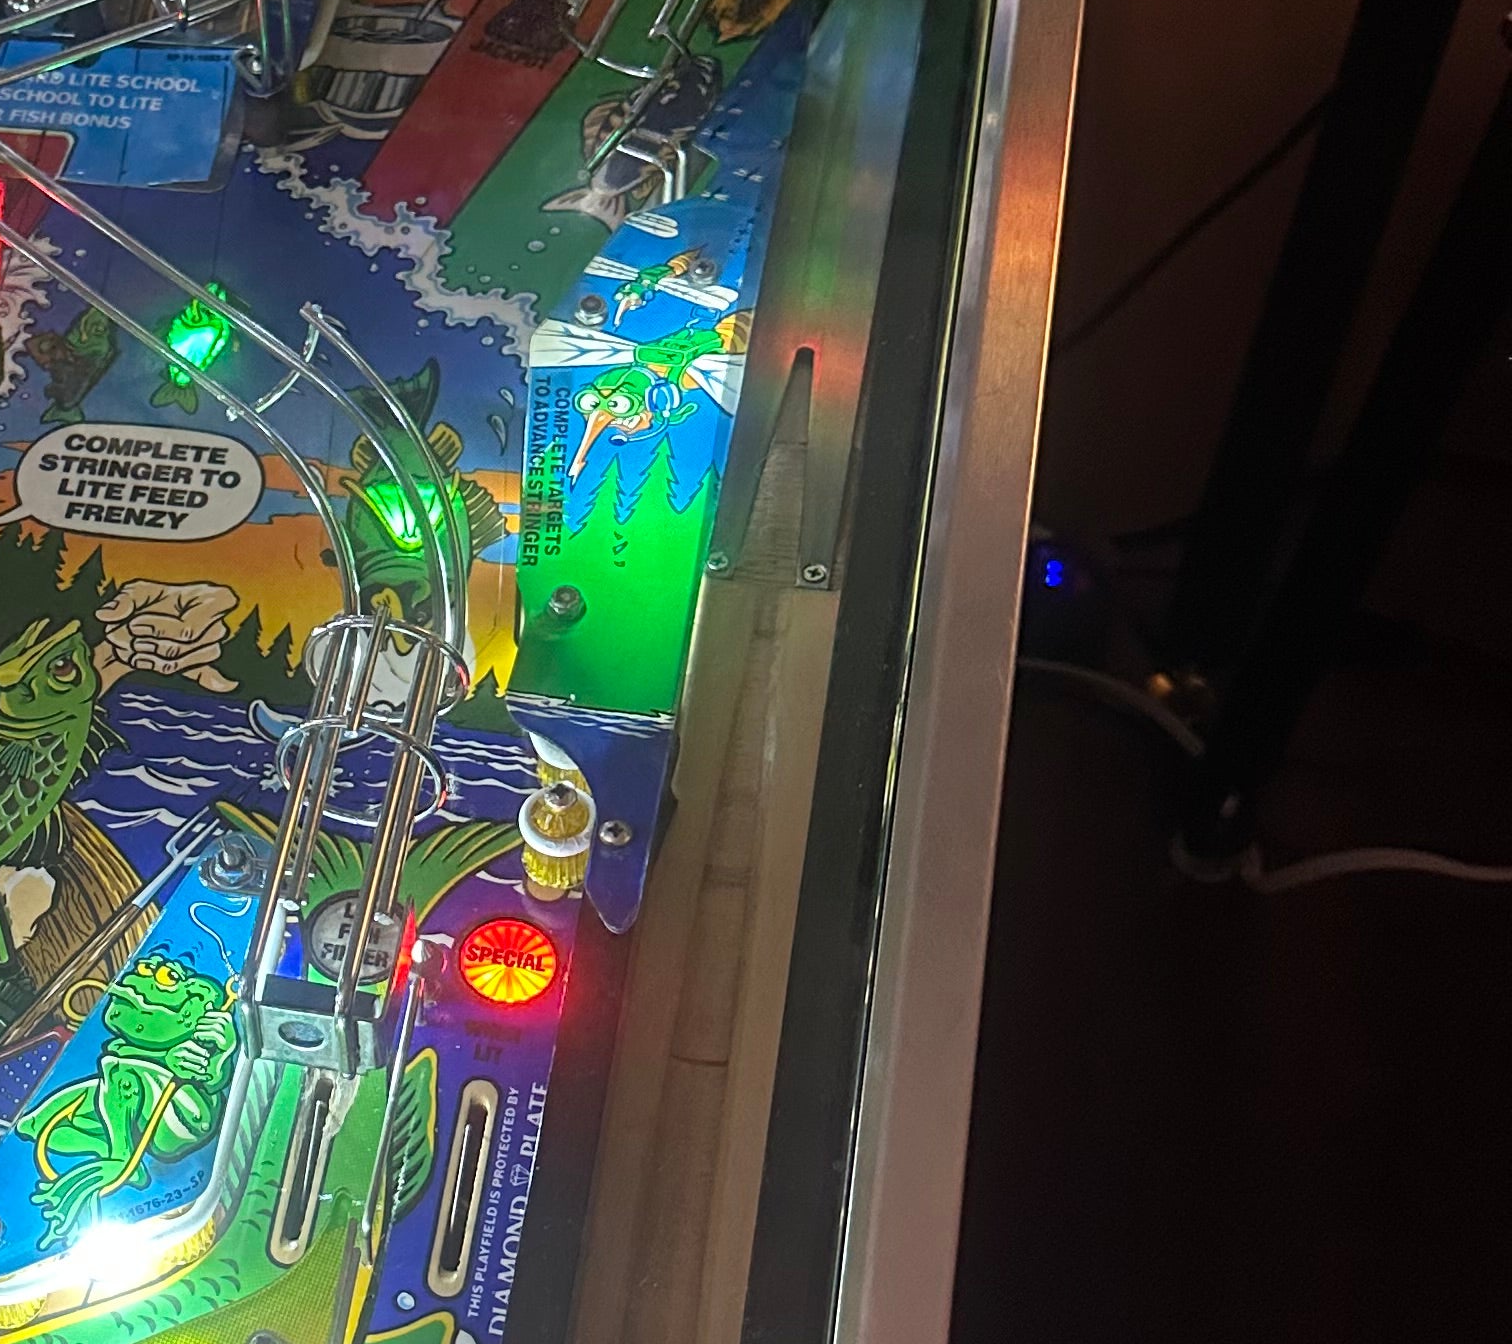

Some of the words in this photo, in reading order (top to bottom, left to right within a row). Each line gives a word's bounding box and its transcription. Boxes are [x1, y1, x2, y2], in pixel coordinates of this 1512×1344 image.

[68, 72, 111, 88] LITE
[116, 75, 201, 94] SCHOOL
[89, 92, 114, 109] TO
[119, 96, 164, 112] LITE
[9, 109, 55, 125] FISH
[59, 112, 131, 130] BONUS
[534, 376, 551, 397] TO
[528, 404, 550, 477] ADVANCE
[550, 387, 571, 474] COMPLETE
[65, 433, 229, 465] COMPLETE
[39, 454, 193, 485] STRINGER
[200, 468, 241, 489] TO
[57, 478, 125, 501] LITE
[130, 485, 209, 508] FEED
[65, 501, 189, 530] FRENZY
[522, 479, 544, 567] STRINGER
[544, 479, 565, 556] TARGETS
[465, 943, 546, 972] SPECIAL
[508, 1087, 520, 1106] BY
[491, 1107, 517, 1189] PROTECTED
[493, 1190, 501, 1205] IS
[474, 1205, 497, 1282] PLAYFIELD
[467, 1284, 484, 1317] THIS
